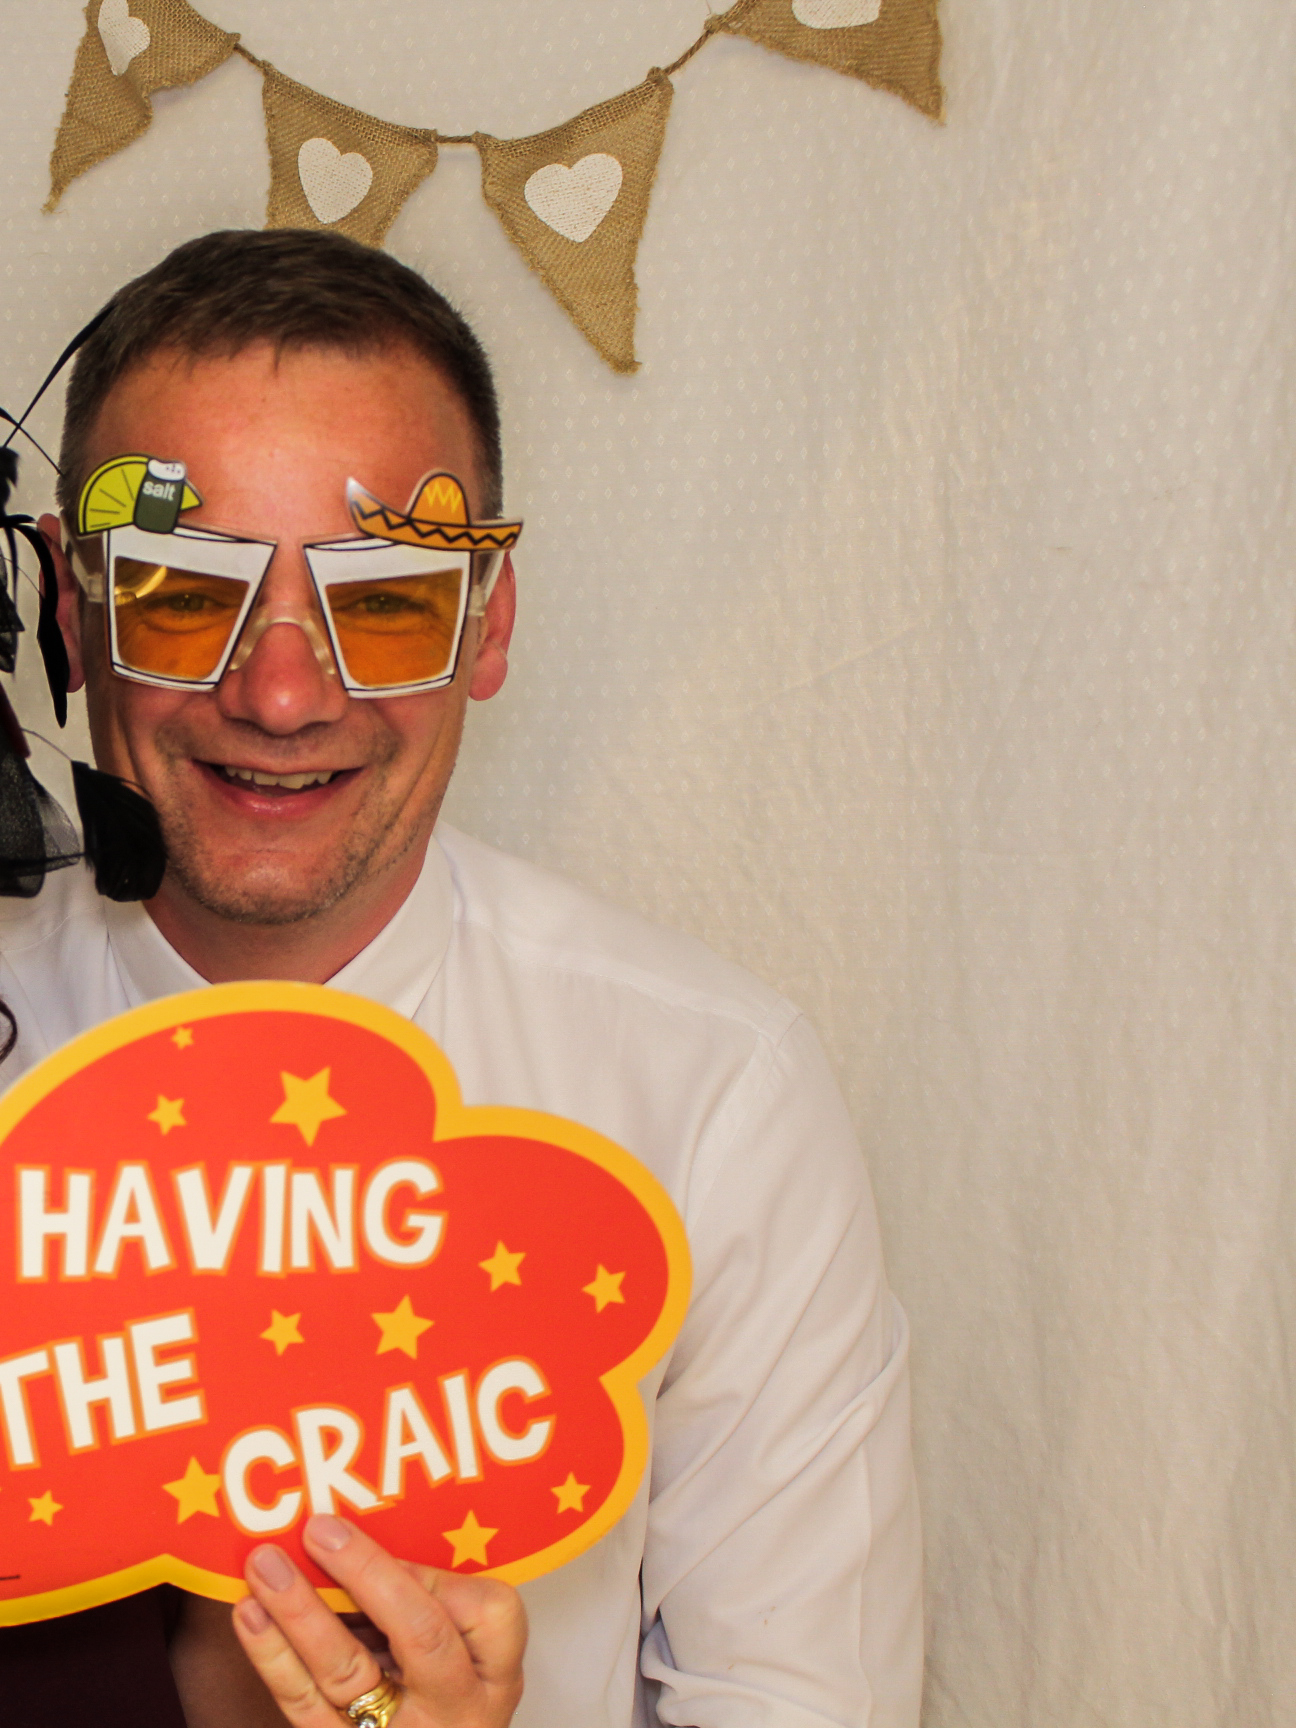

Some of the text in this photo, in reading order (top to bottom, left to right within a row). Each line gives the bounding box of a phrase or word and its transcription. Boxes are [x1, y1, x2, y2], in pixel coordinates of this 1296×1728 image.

[142, 480, 176, 502] salt
[18, 1159, 445, 1279] HAVING
[223, 1359, 553, 1533] CRAIC
